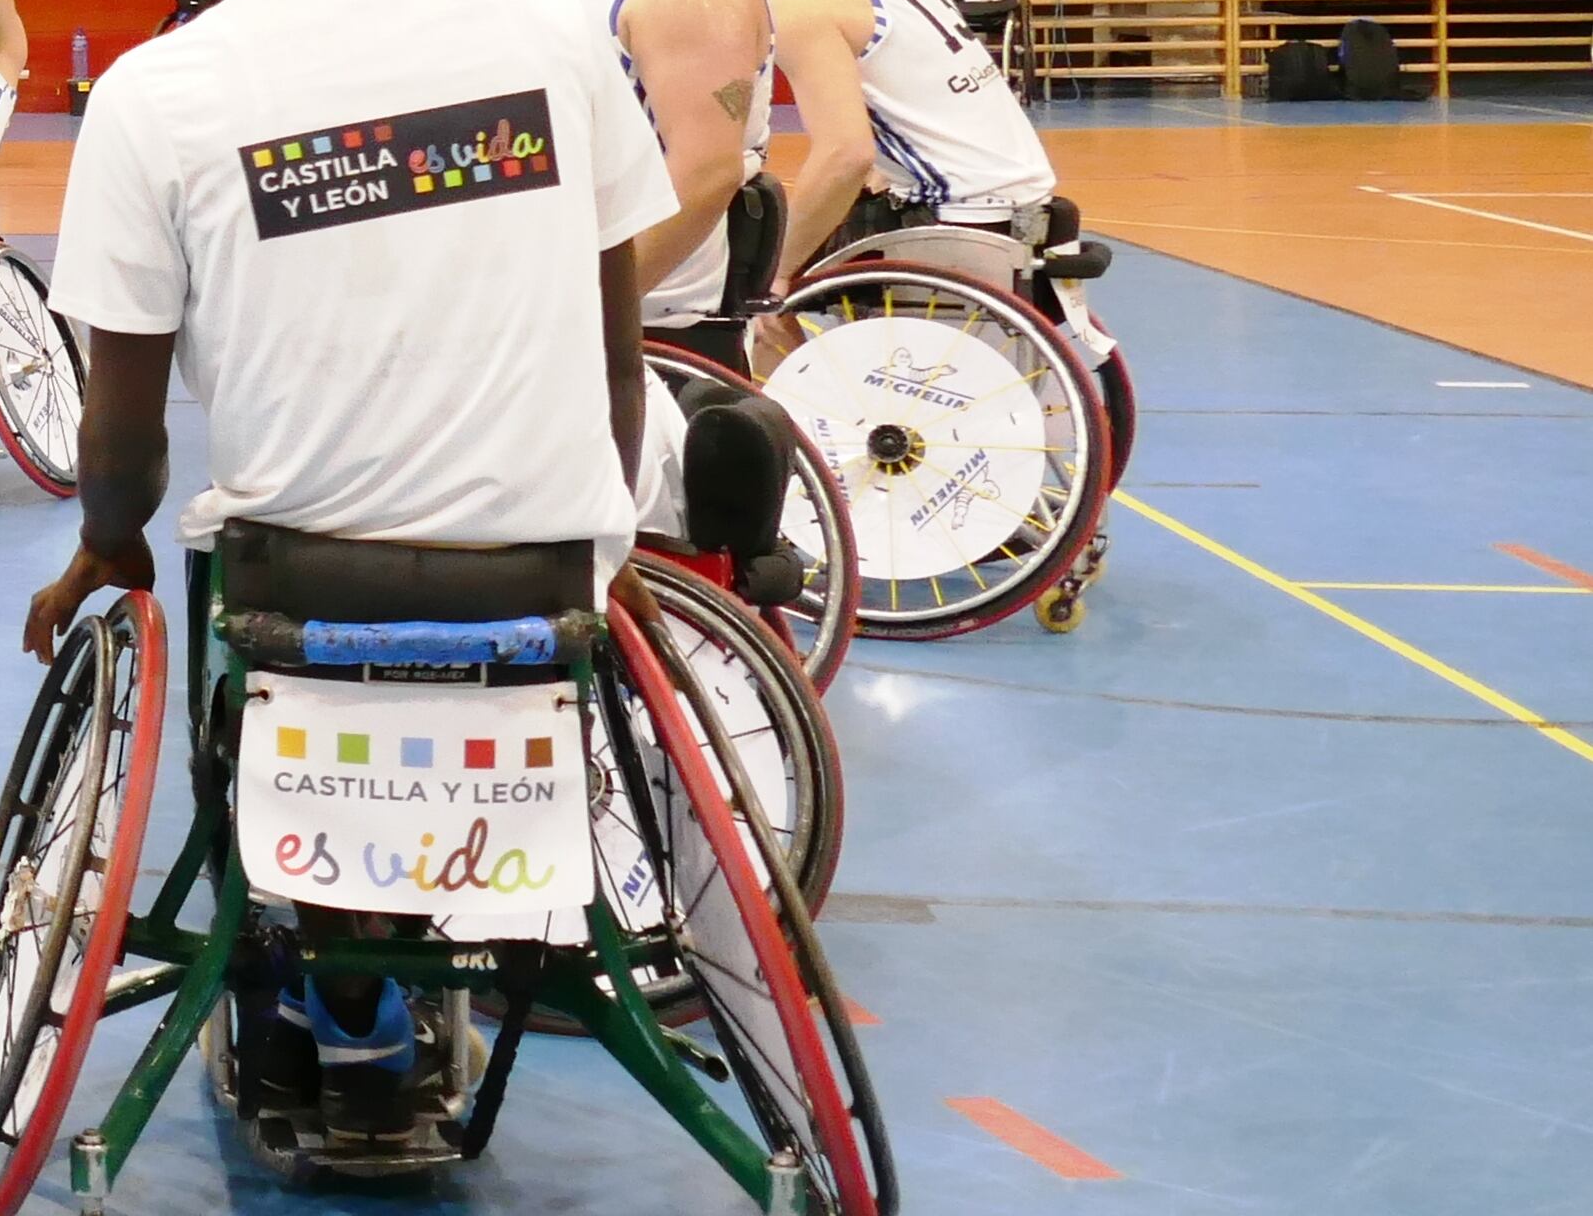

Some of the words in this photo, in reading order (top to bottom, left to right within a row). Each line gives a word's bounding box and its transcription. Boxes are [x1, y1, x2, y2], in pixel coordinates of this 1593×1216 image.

[259, 147, 398, 194] CASTILLA
[408, 144, 446, 174] es
[450, 118, 544, 168] vida
[281, 197, 299, 219] Y
[310, 179, 390, 215] LEÓN
[273, 771, 428, 803] CASTILLA
[442, 782, 462, 804] Y
[473, 776, 556, 805] LEÓN
[275, 832, 341, 886] es
[363, 817, 556, 894] vida
